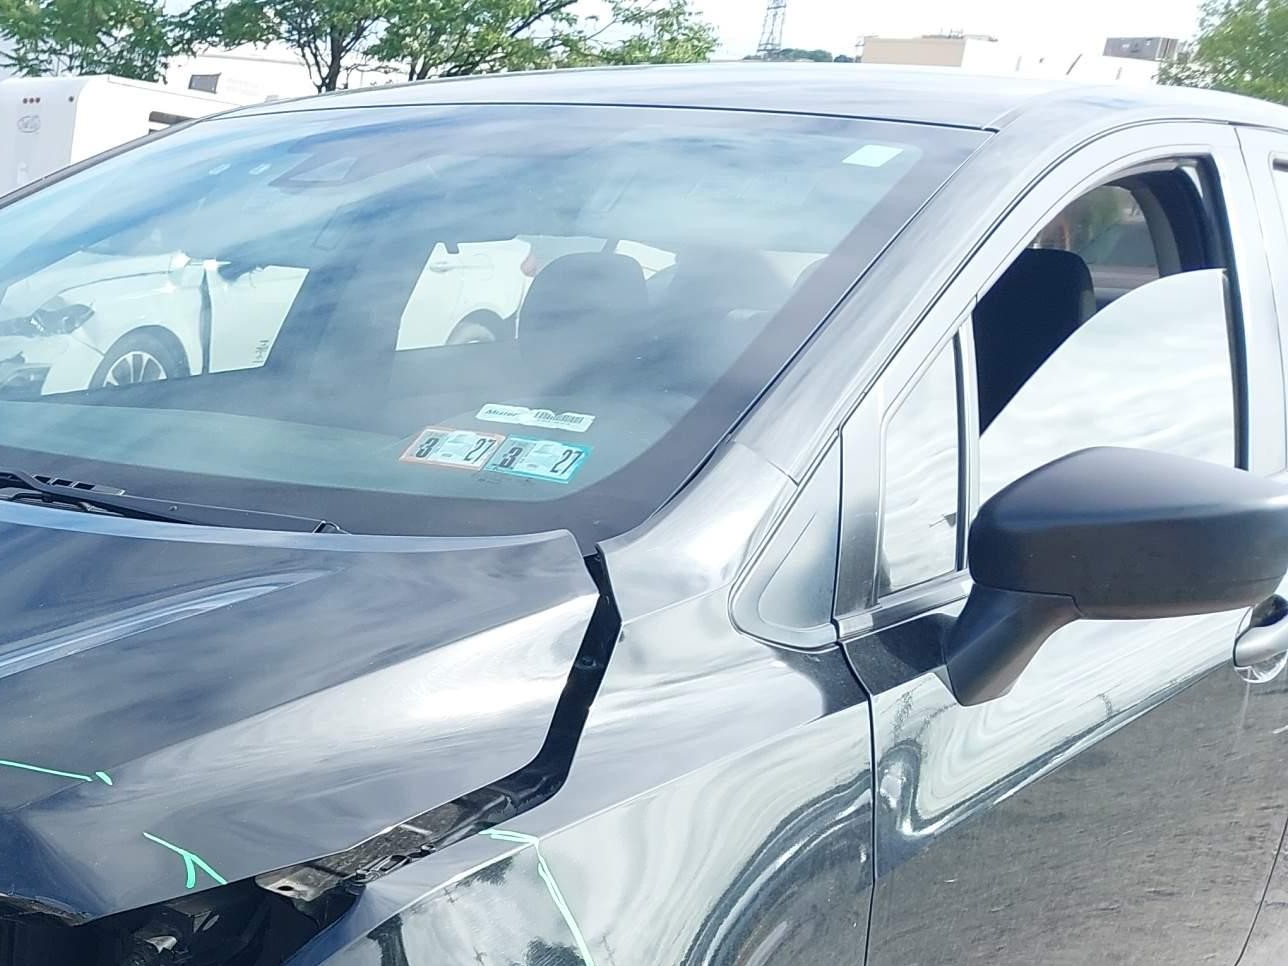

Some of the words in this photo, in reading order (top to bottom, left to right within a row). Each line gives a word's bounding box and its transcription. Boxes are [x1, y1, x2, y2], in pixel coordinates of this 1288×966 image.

[415, 437, 439, 458] 3
[464, 438, 496, 464] 27
[499, 446, 523, 470] 3
[550, 449, 584, 475] 27
